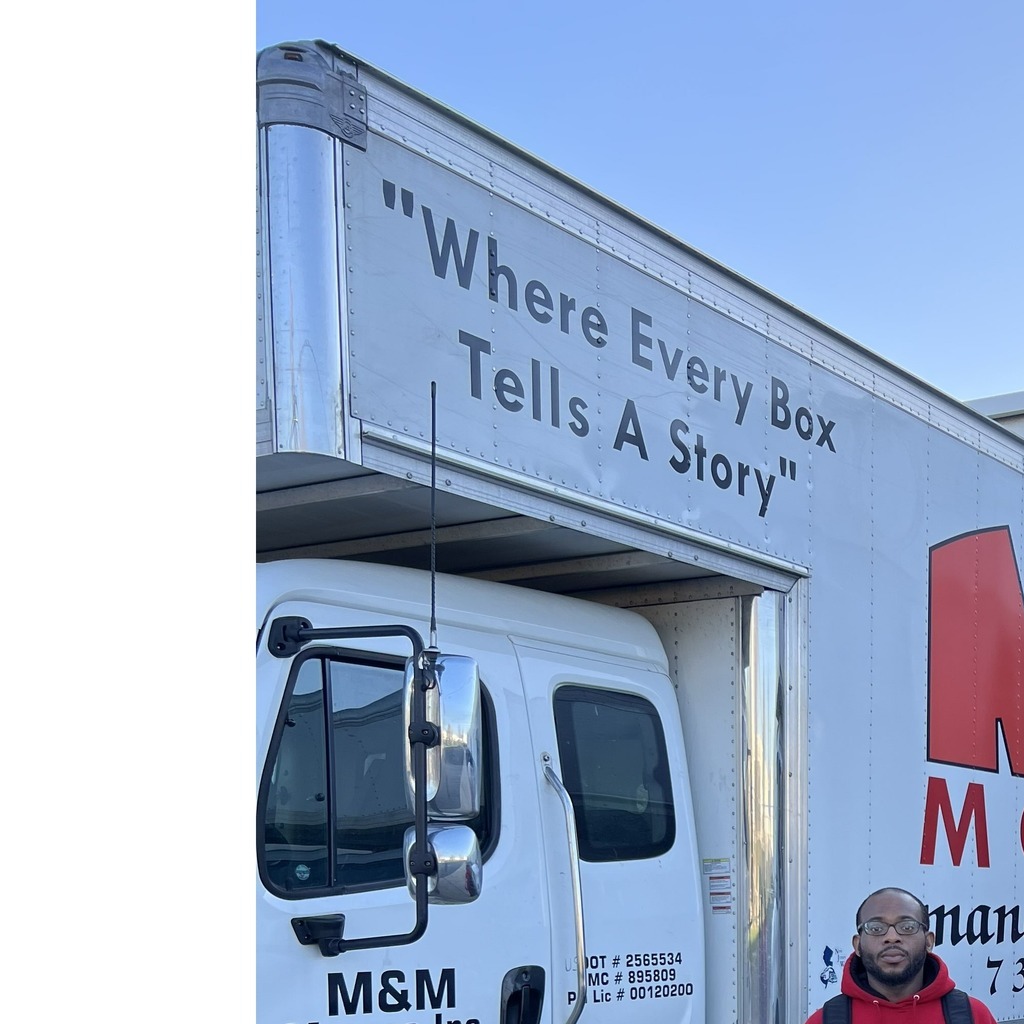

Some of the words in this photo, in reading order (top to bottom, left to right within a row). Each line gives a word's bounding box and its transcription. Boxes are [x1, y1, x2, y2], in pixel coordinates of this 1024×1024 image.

[382, 179, 608, 348] "Where
[630, 307, 753, 426] Every
[770, 376, 837, 453] Box
[458, 330, 589, 438] Tells
[613, 399, 649, 461] A
[669, 418, 797, 518] Story"
[588, 972, 609, 986] MC
[628, 968, 676, 984] 895809
[626, 952, 682, 968] 2565534
[327, 968, 456, 1016] M&M
[593, 989, 612, 1003] Lic
[630, 983, 693, 1000] 00120200
